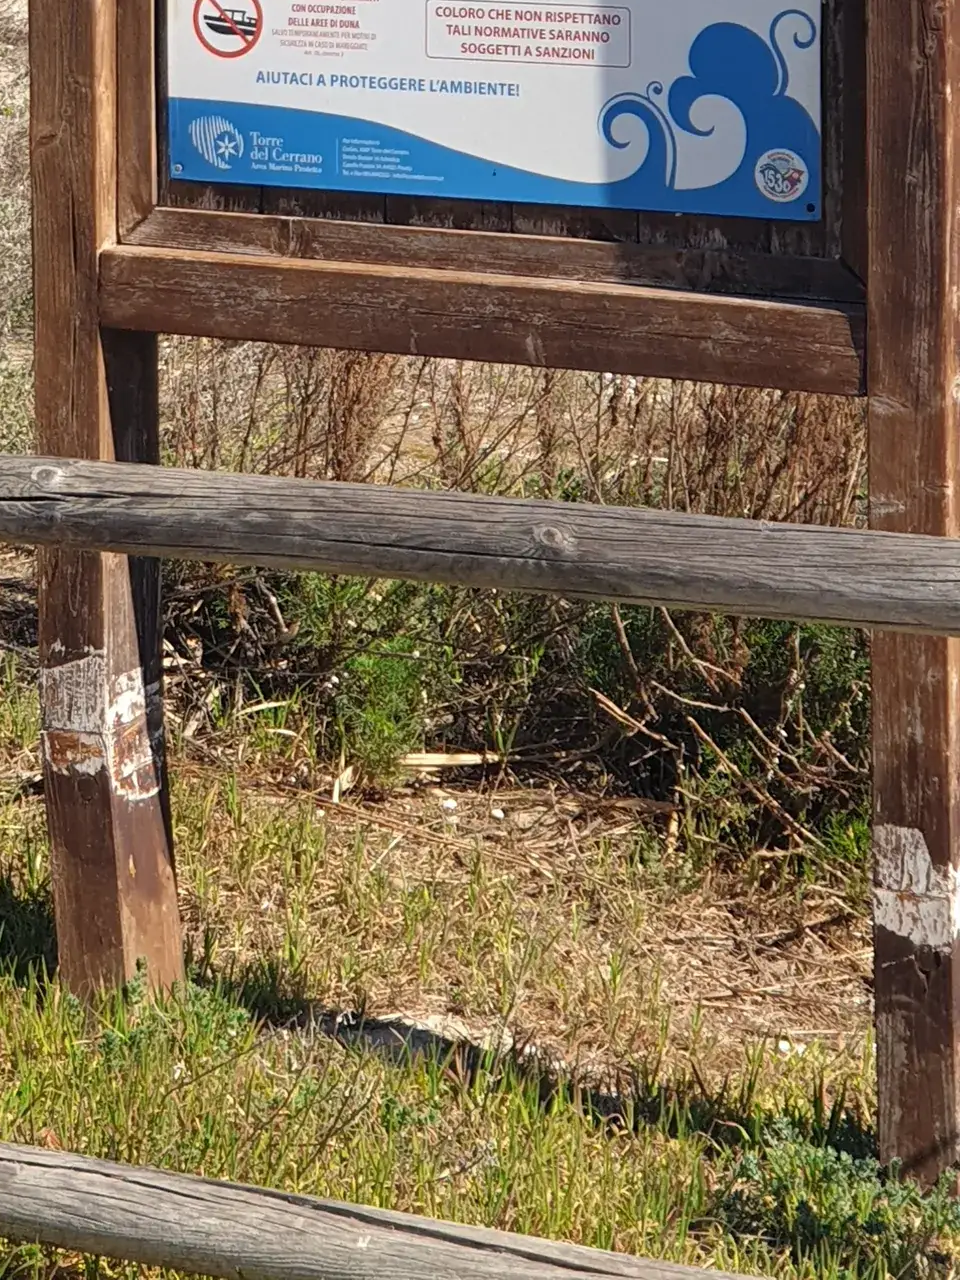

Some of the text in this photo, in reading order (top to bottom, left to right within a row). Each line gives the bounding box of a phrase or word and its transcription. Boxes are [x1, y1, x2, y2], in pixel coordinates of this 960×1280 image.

[291, 3, 357, 15] CON OCCUPAZIONE
[435, 6, 621, 26] COLORO CHE NON RISPETTANO
[287, 17, 361, 29] DELLE AREE DI DUNA
[446, 23, 610, 43] TALI NORMATIVE SARANNO
[460, 42, 595, 60] SOGGETTI A SANZIONI
[255, 70, 519, 96] AIUTACI A PROTEGGERE L'AMBIENTE!
[249, 131, 284, 146] Torre
[250, 146, 323, 164] del Cerrano
